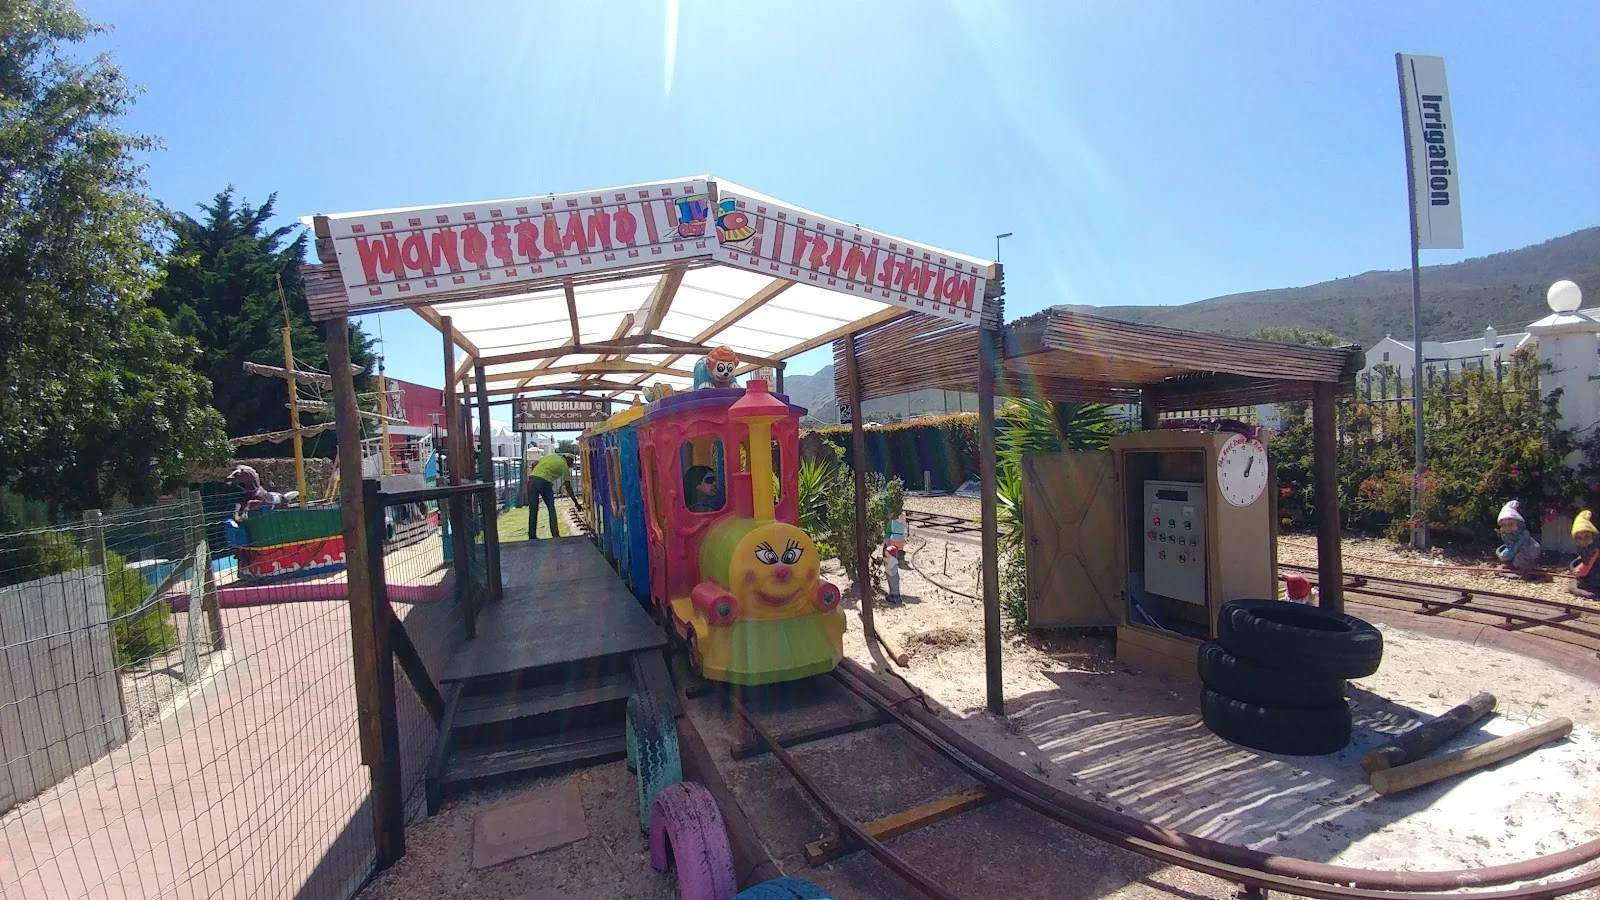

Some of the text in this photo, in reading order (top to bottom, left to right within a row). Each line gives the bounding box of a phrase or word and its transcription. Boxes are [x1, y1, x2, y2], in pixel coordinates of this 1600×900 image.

[1421, 95, 1451, 206] Irrigation
[361, 208, 638, 276] WONDERLAND
[797, 231, 976, 306] TRAIN STATION
[518, 422, 552, 430] PAINTBALL
[552, 421, 585, 430] SHOOTING
[531, 401, 593, 411] WONDERLAND
